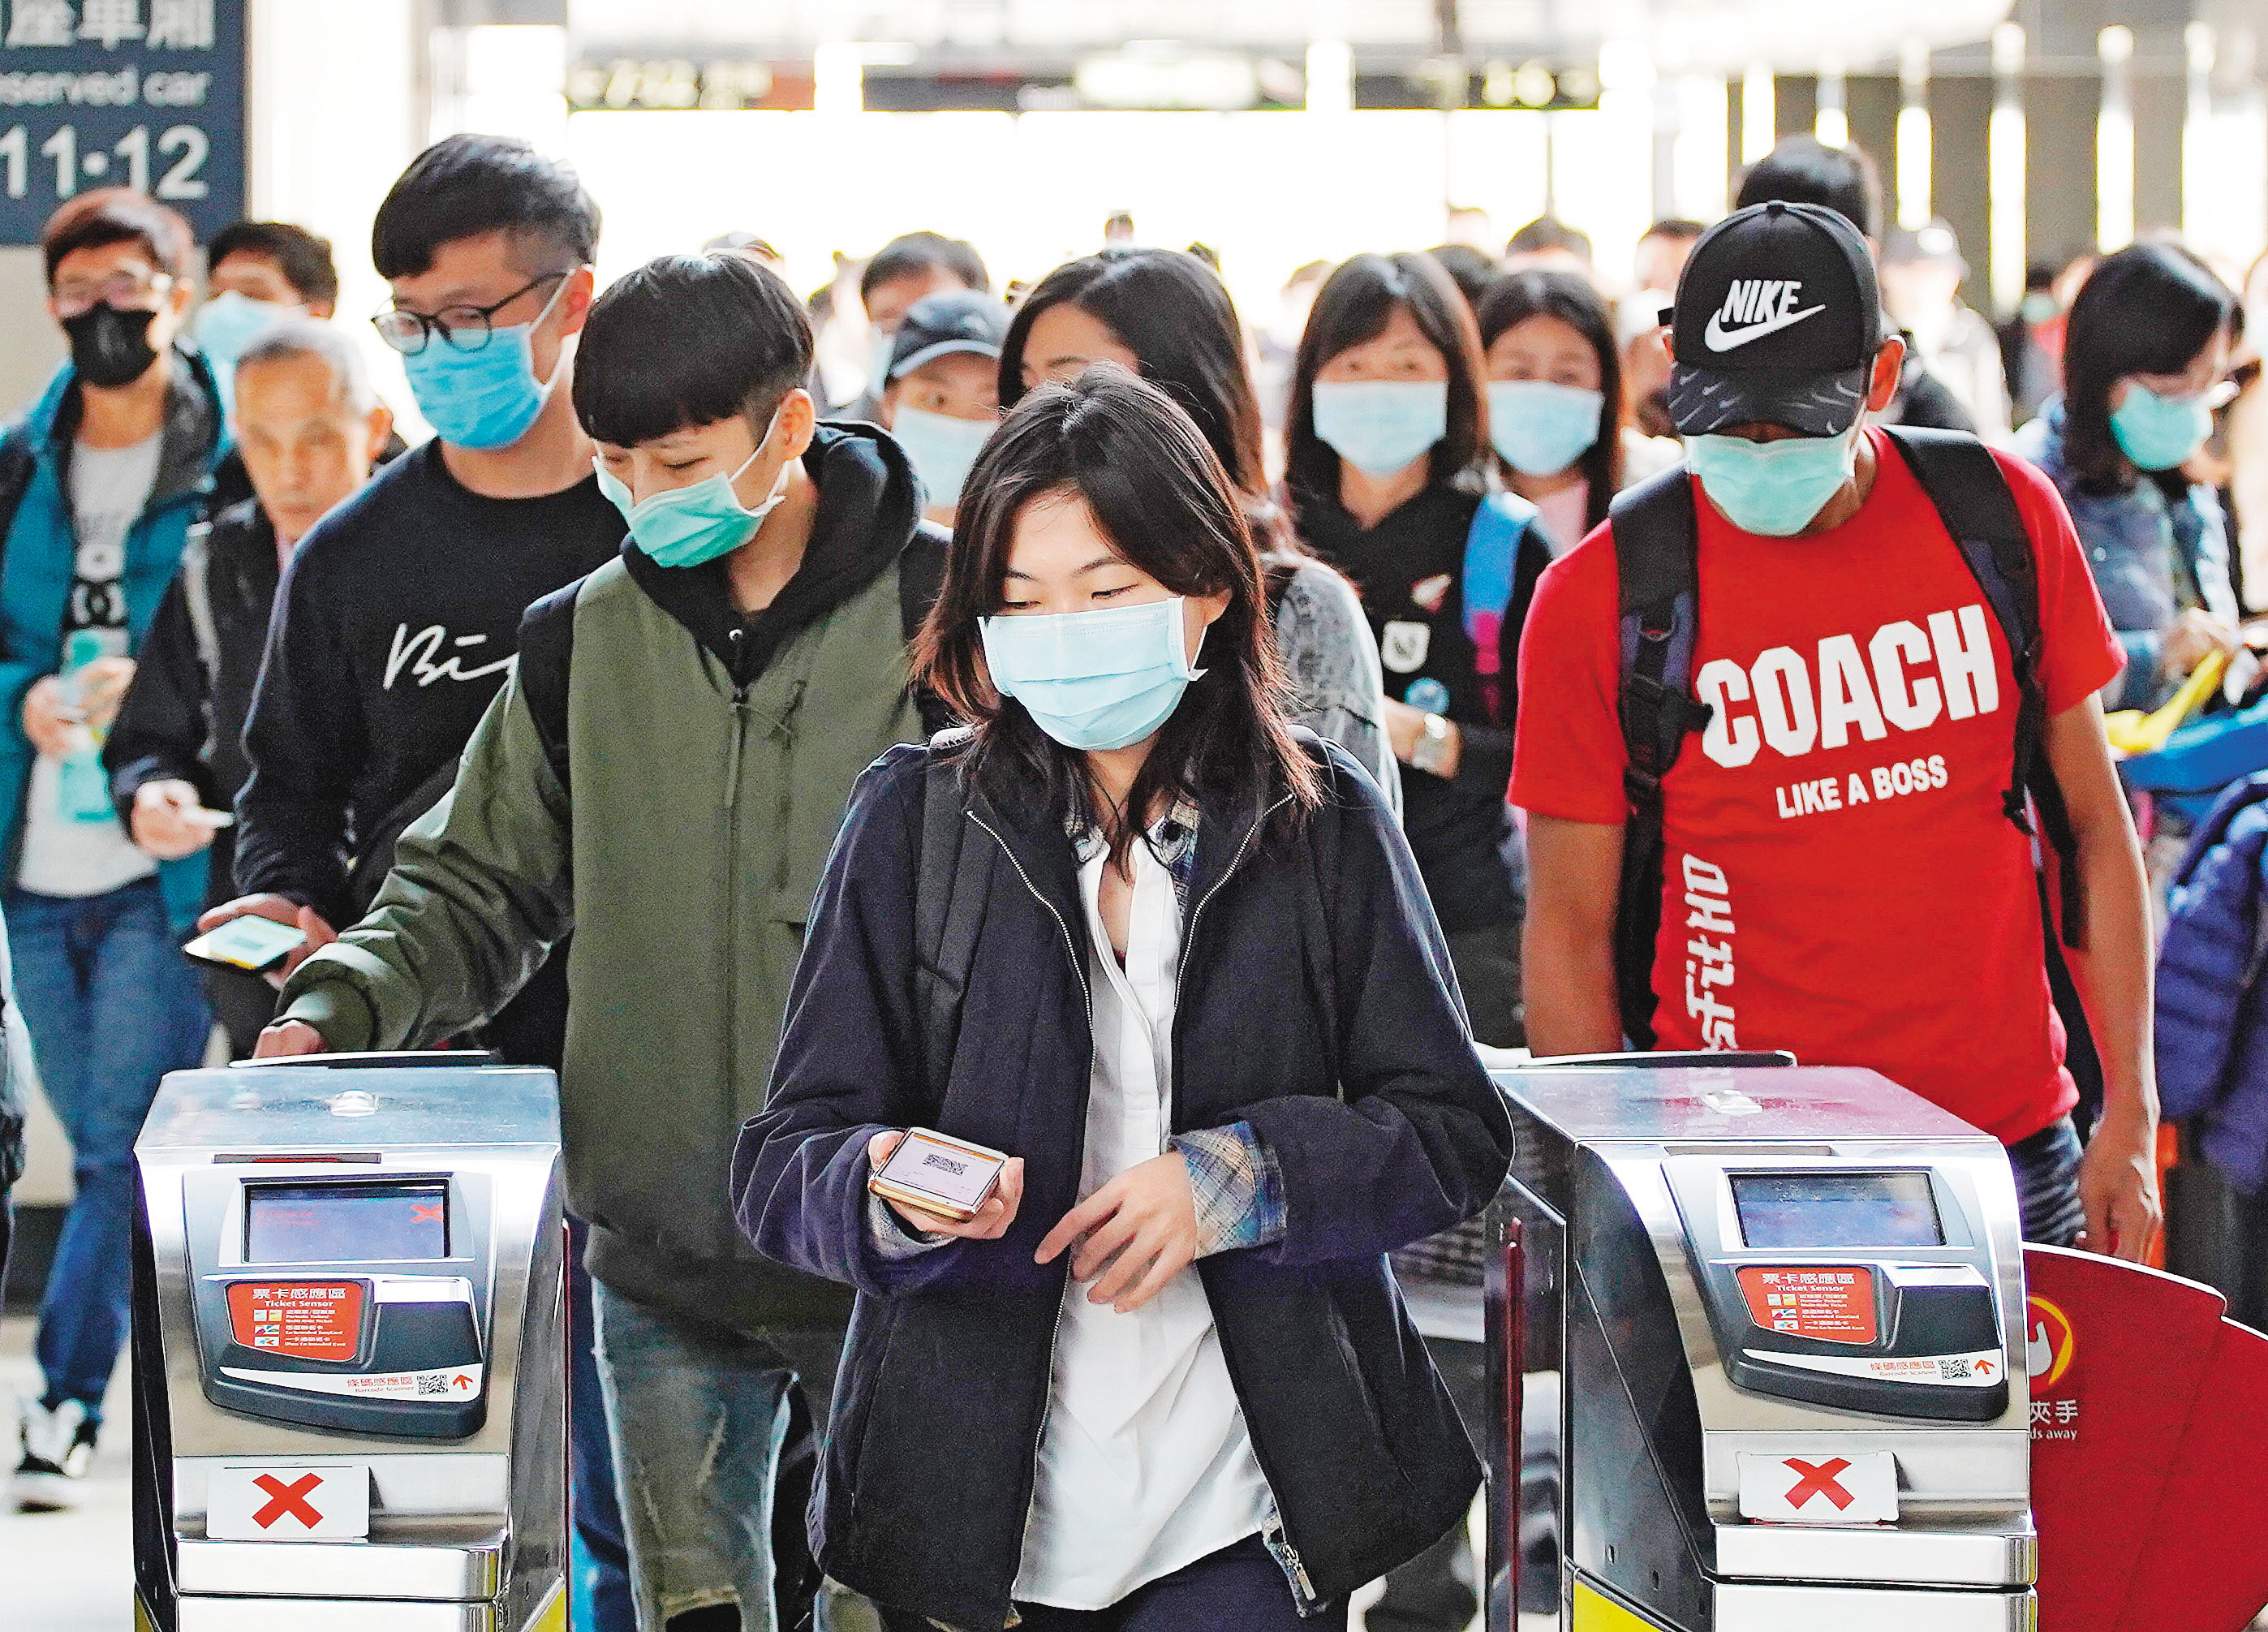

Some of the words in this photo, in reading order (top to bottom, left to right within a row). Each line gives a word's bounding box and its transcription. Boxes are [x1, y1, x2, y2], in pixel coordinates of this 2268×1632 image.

[144, 71, 213, 106] car
[1720, 279, 1802, 323] NIKE
[1696, 604, 2000, 769] COACH
[1775, 777, 1843, 819] LIKE
[1848, 773, 1870, 806] A
[1870, 754, 1948, 800] BOSS
[1762, 1272, 1856, 1285] 票卡感應區
[252, 1288, 346, 1299] 票卡感應區
[2030, 1400, 2079, 1424] 夾手
[2046, 1430, 2077, 1440] away
